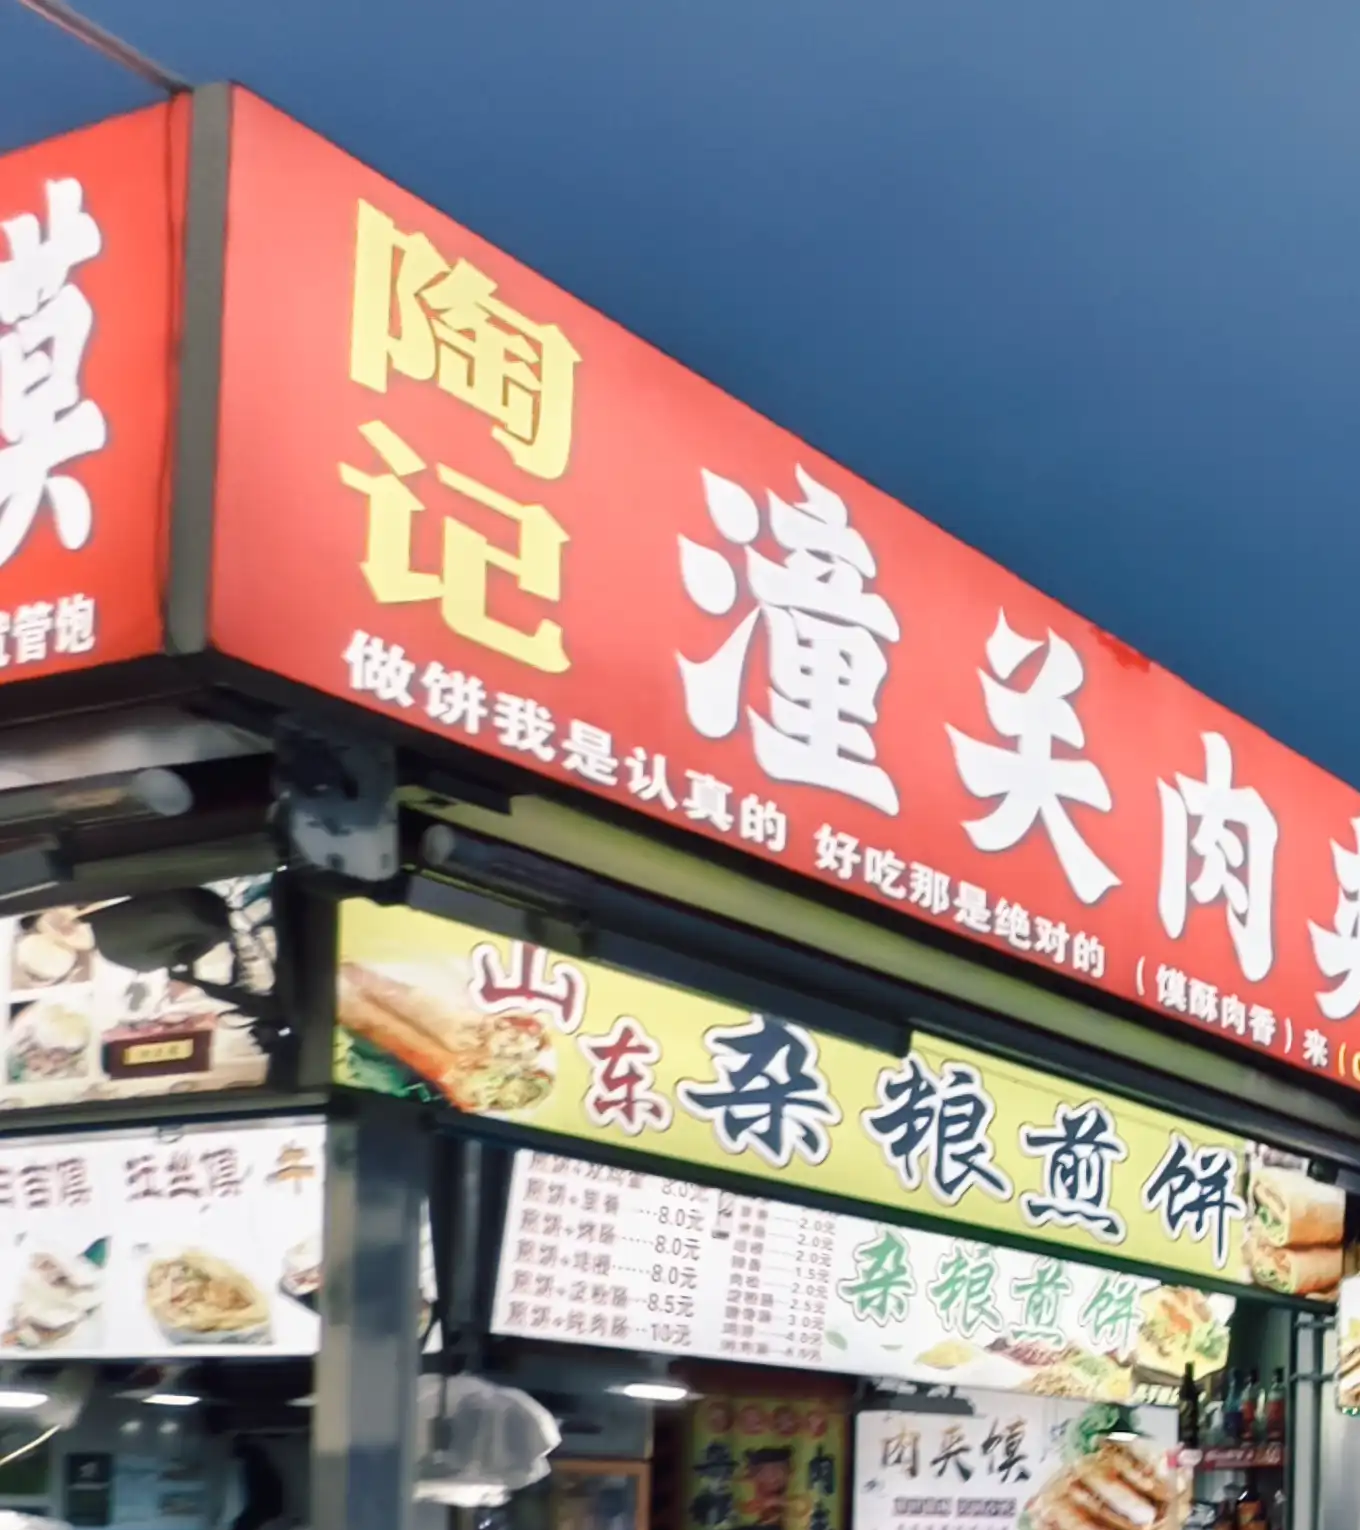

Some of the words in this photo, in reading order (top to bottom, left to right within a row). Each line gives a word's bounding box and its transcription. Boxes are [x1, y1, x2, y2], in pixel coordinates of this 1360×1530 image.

[337, 197, 582, 673] 陶记
[341, 630, 788, 853] 做饼我是认真的
[814, 823, 1106, 978] 好吃那是绝对的
[657, 1206, 704, 1233] 8.0元
[654, 1234, 701, 1262] 8.0元
[651, 1264, 698, 1291] 8.0元
[838, 1226, 1142, 1357] 杂粮煎饼
[648, 1292, 695, 1320] 8.5元
